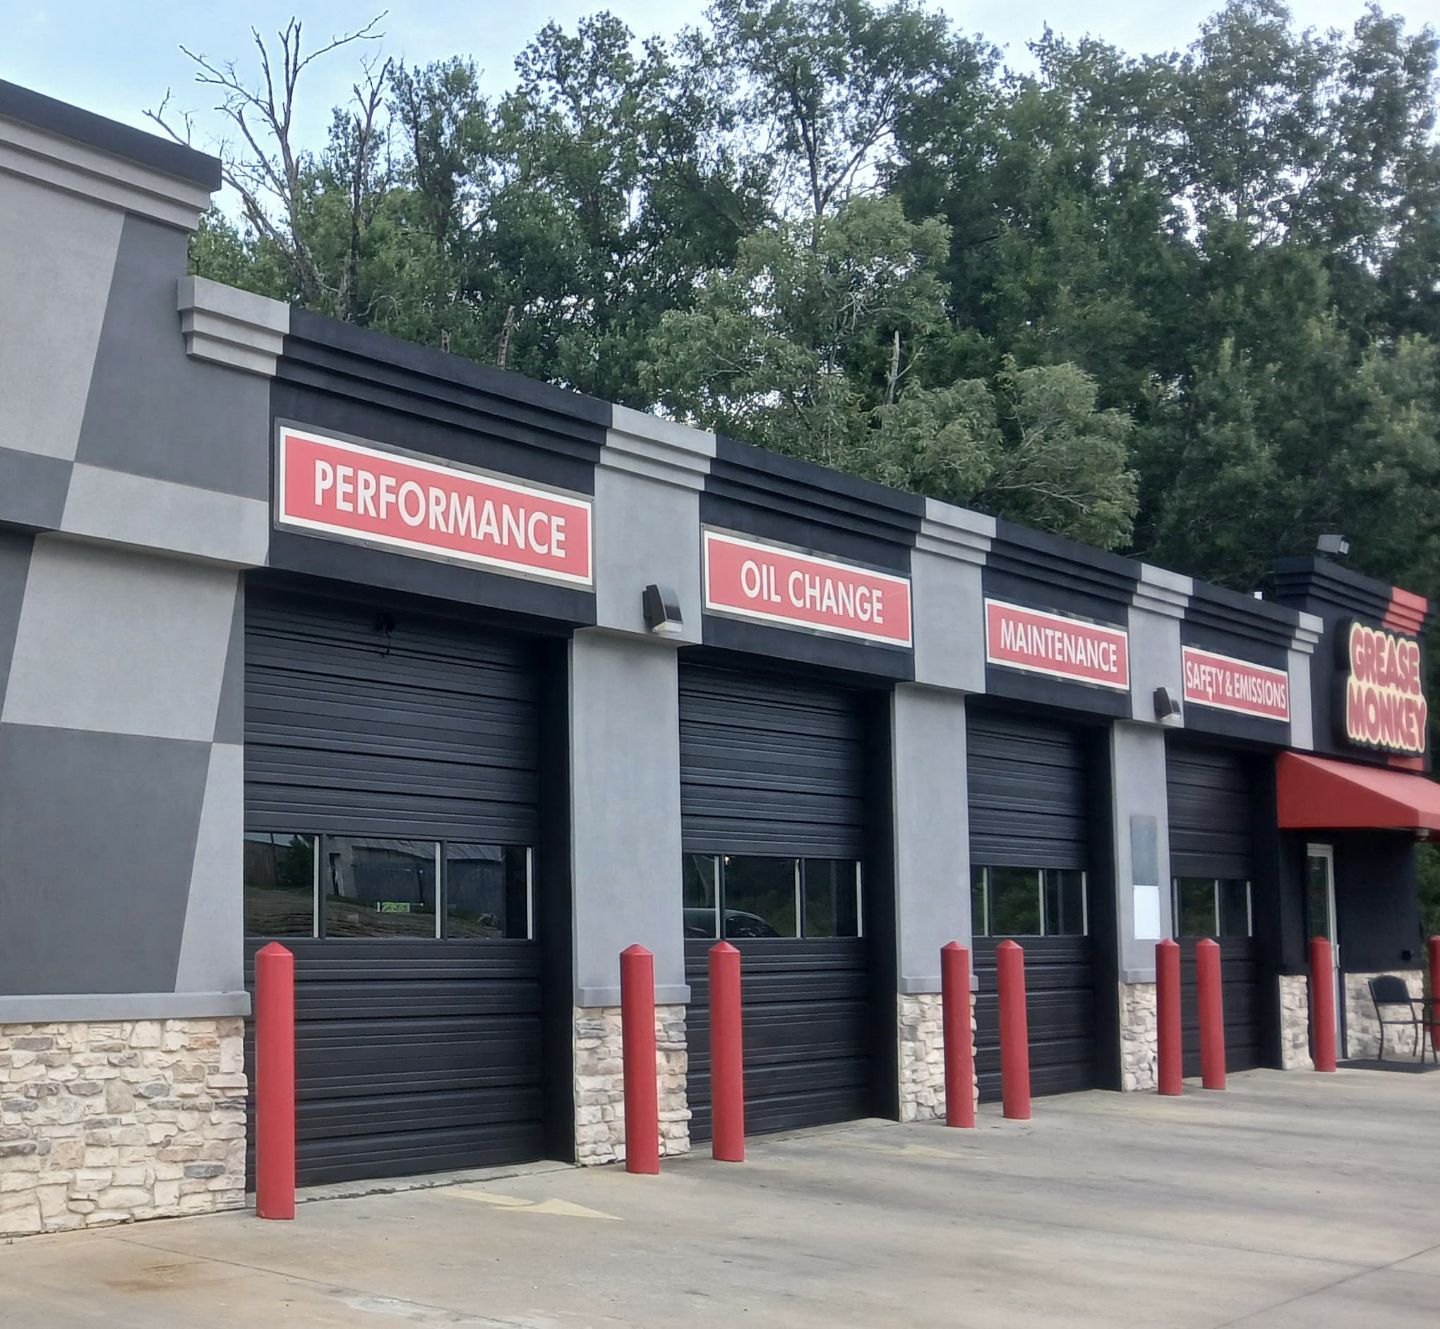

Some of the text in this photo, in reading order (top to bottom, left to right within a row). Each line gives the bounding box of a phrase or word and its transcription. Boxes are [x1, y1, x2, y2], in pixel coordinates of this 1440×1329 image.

[314, 459, 566, 558] PERFORMANCE
[740, 559, 884, 624] OIL CHANGE
[1000, 618, 1118, 673] MAINTENANCE
[1351, 627, 1422, 696] GREASE
[1186, 661, 1286, 709] SAFETY & EMISSIONS
[1348, 681, 1426, 750] MONKEY
